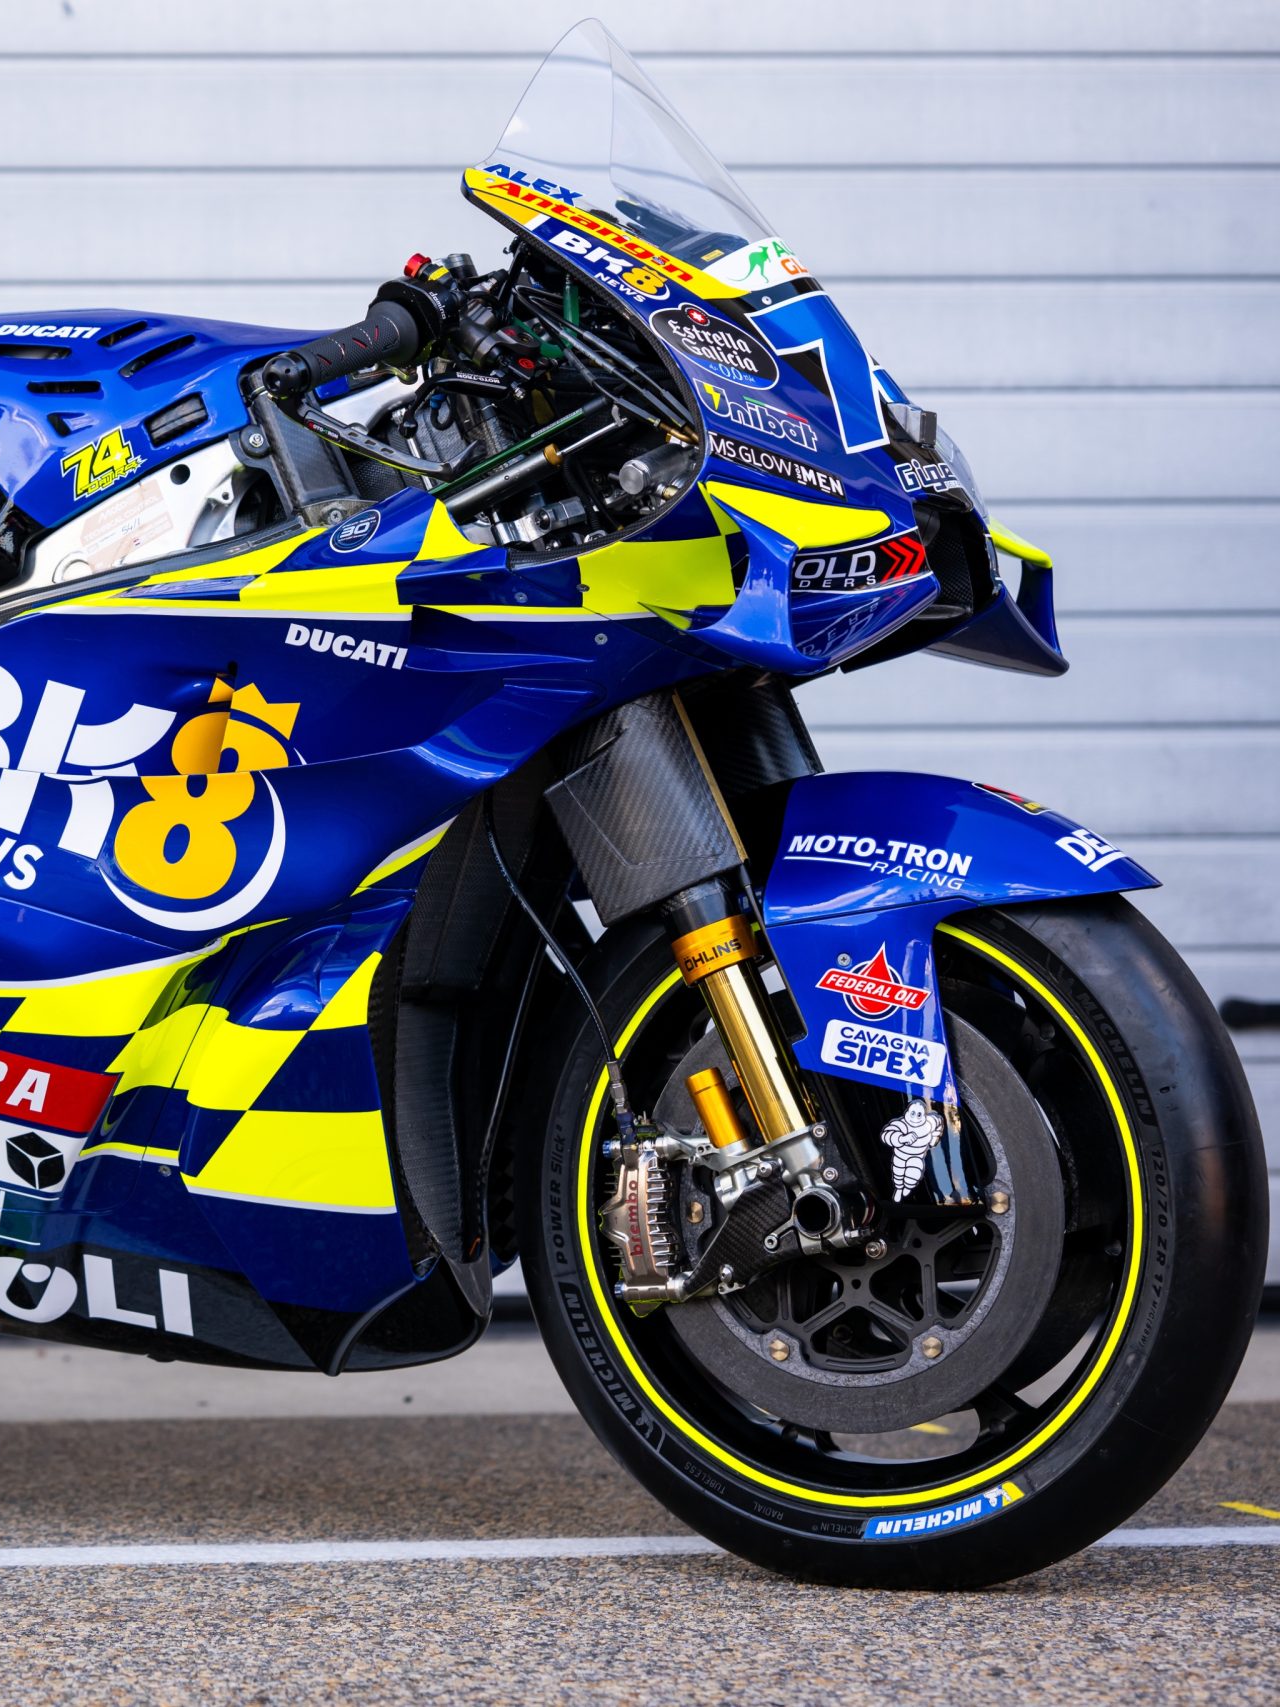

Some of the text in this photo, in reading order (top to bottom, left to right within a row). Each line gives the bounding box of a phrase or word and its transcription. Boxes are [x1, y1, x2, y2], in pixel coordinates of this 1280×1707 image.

[483, 163, 583, 207] ALEX
[487, 181, 694, 282] Antangin
[549, 230, 666, 295] BK8
[594, 272, 647, 303] NEWS
[668, 319, 753, 356] Estrella
[682, 338, 759, 373] Galicia
[693, 378, 818, 452] Unibat
[61, 426, 134, 500] 74
[739, 446, 792, 476] GLOW
[801, 467, 845, 497] MEN
[340, 522, 371, 538] 30
[284, 623, 409, 670] DUCATI
[788, 835, 973, 877] MOTO-TRON
[870, 861, 966, 891] RACING
[683, 938, 742, 972] ÖHLINS
[825, 974, 919, 1005] FEDERAL OIL
[834, 1040, 929, 1080] SIPEX
[840, 1026, 931, 1057] CAVAGNA
[1076, 990, 1153, 1116] MICHELIN
[1152, 1150, 1168, 1228] 120/70
[550, 1182, 568, 1265] POWER
[625, 1180, 646, 1257] brembo
[1155, 1237, 1167, 1267] ZR
[1152, 1274, 1164, 1301] 17
[565, 1292, 637, 1412] MICHELIN
[684, 1460, 727, 1495] TUBELESS
[753, 1502, 784, 1521] RADIAL
[875, 1499, 982, 1535] MICHELIN
